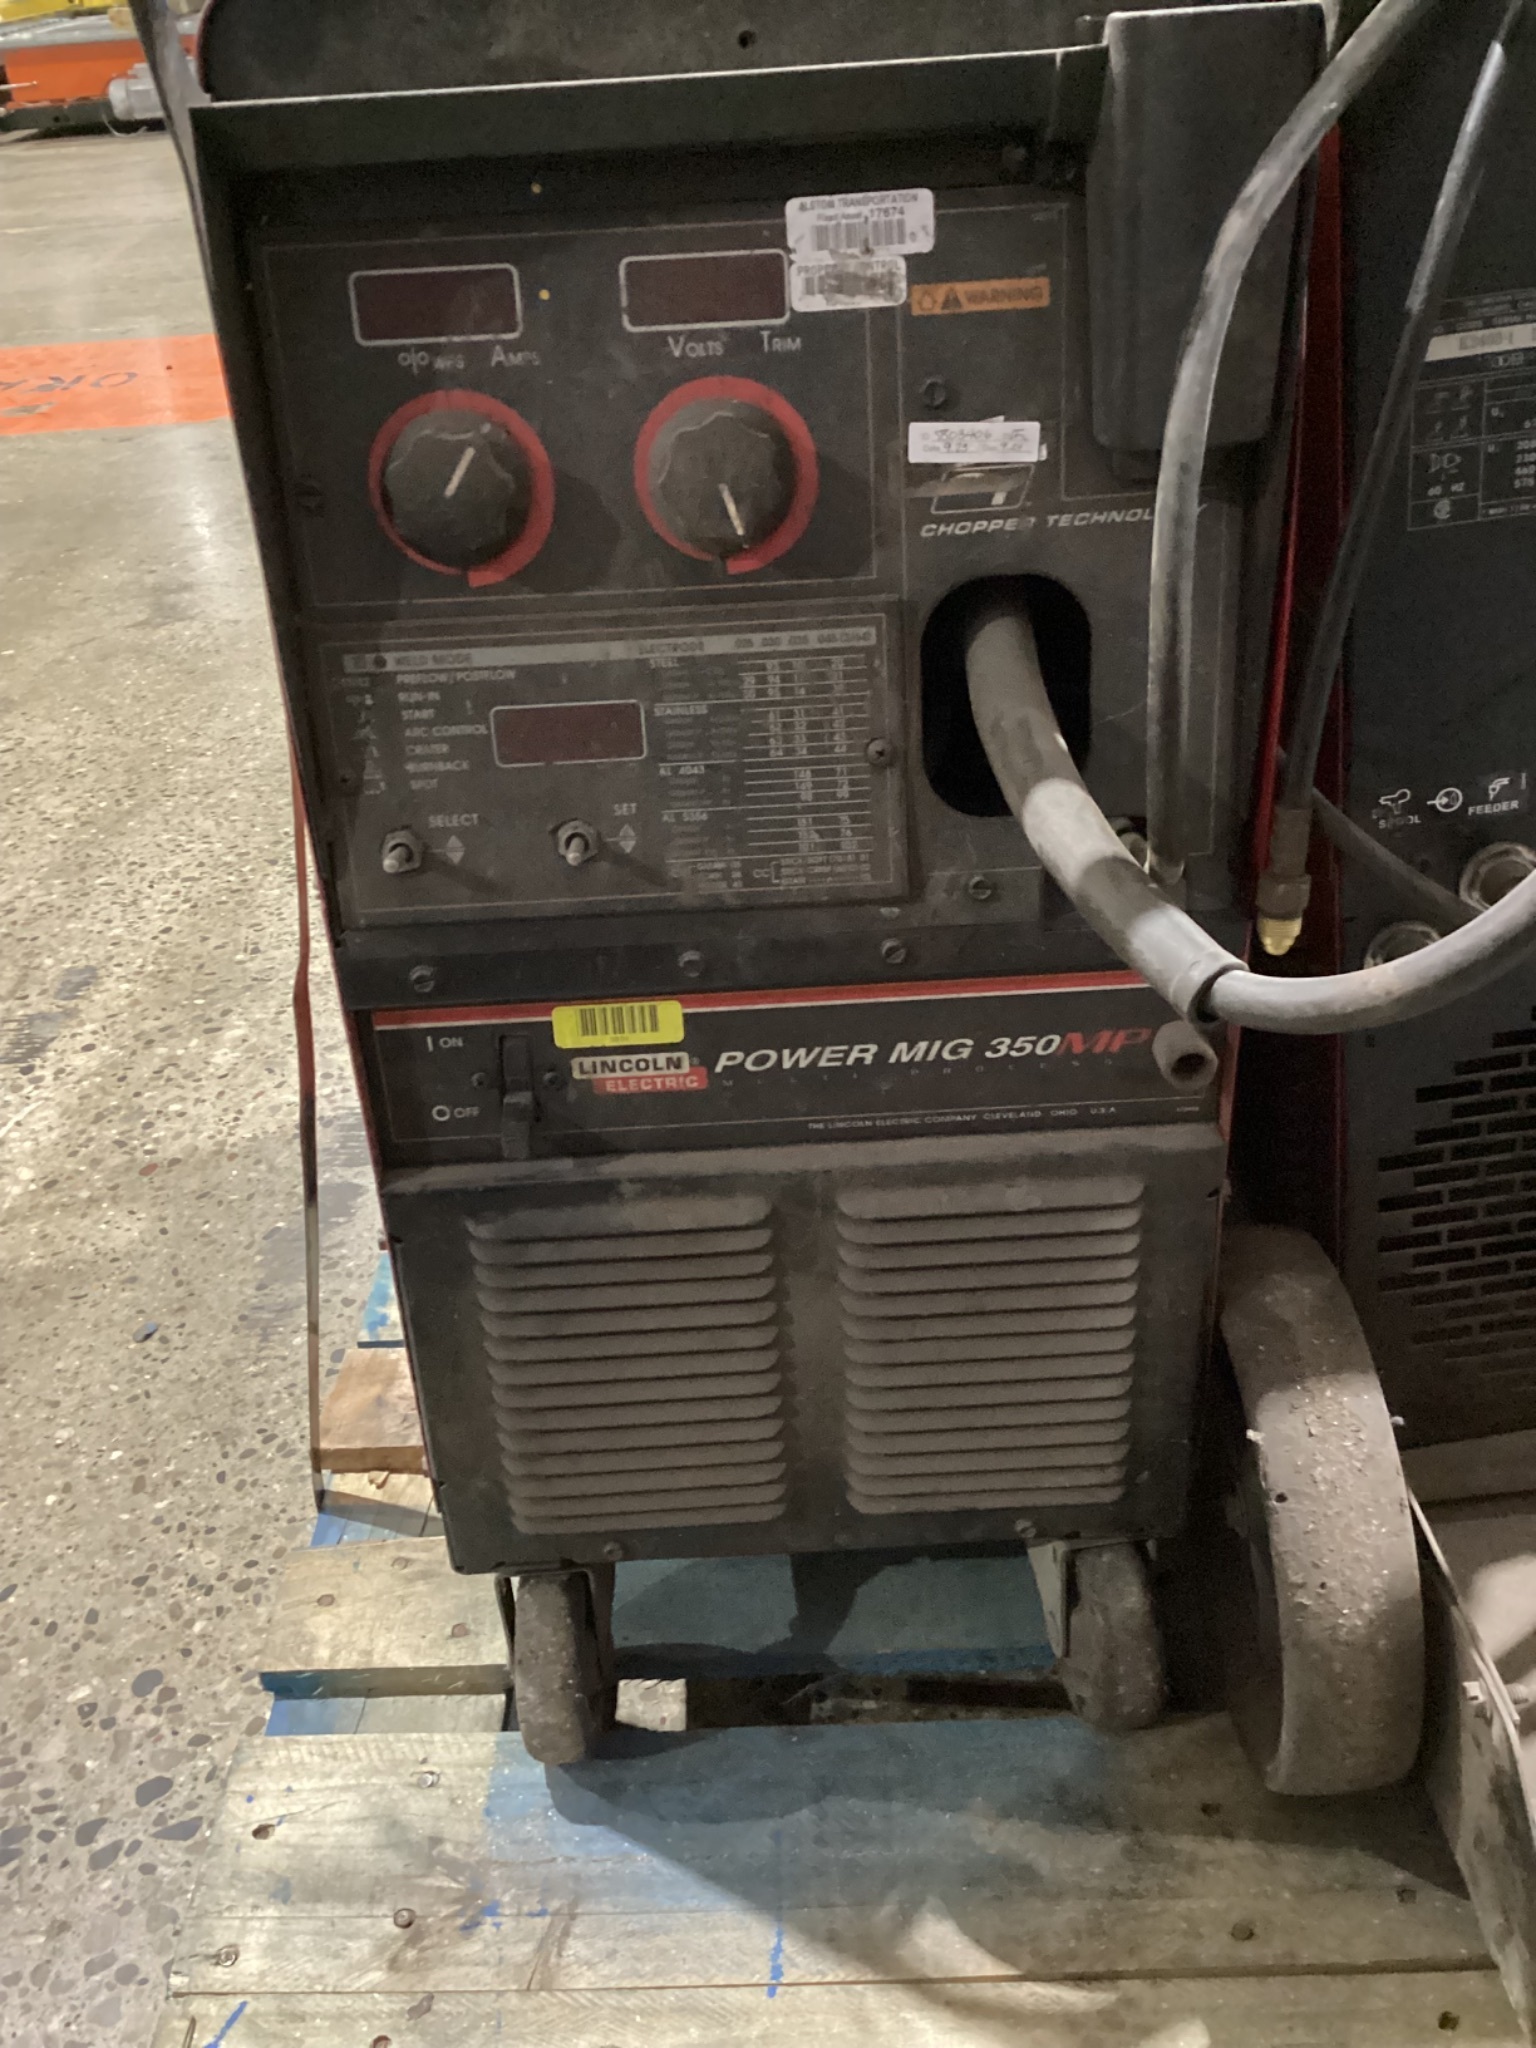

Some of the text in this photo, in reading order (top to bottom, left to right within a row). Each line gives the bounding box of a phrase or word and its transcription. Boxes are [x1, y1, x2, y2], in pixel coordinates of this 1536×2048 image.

[838, 192, 919, 209] TRANSPORTATION
[665, 330, 802, 360] VOLTS TRIM
[431, 723, 489, 737] CONTROL
[613, 801, 639, 817] SET
[1467, 799, 1520, 816] FEEDER
[427, 812, 482, 829] SELECT
[439, 1036, 464, 1049] ON
[714, 1042, 878, 1074] POWER
[887, 1038, 975, 1066] MIG
[578, 1056, 684, 1075] LINCOLN
[604, 1075, 699, 1092] ELECTRIC
[453, 1106, 481, 1119] OFF
[874, 1116, 922, 1128] ELECTRIC
[923, 1113, 978, 1126] COMPANY
[1050, 1107, 1079, 1117] OHIO
